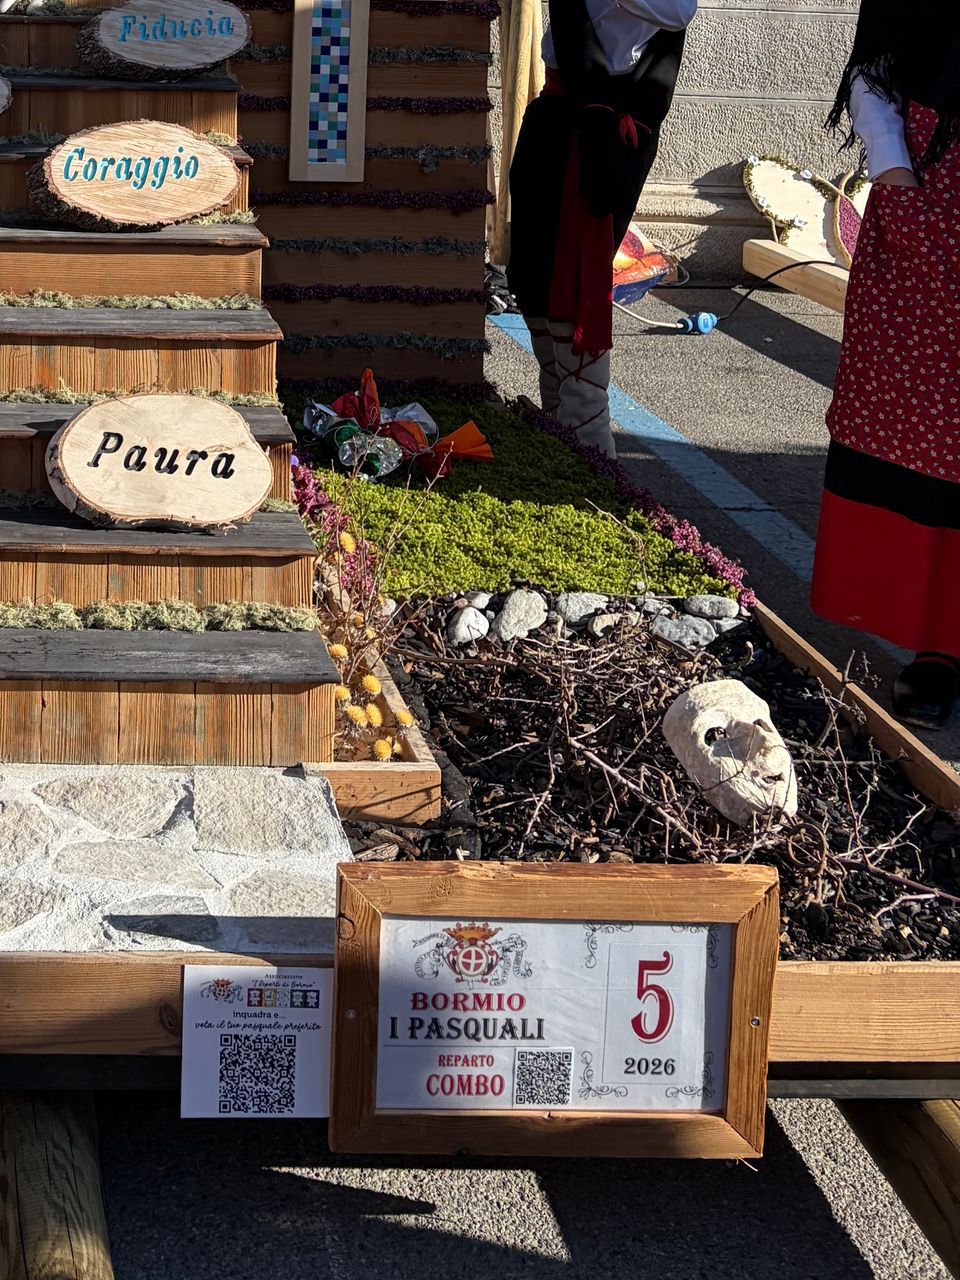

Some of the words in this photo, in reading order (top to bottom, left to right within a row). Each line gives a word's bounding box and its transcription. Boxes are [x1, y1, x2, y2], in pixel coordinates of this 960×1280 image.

[118, 10, 234, 43] Fiducia
[62, 146, 200, 190] Coraggio
[86, 431, 236, 480] Paura
[411, 992, 527, 1013] BORMIO
[631, 950, 675, 1044] 5
[195, 1020, 215, 1029] vota
[216, 1020, 225, 1029] il
[227, 1020, 241, 1029] tuo
[242, 1021, 283, 1032] pasquale
[283, 1022, 322, 1033] preferito
[233, 1011, 272, 1019] inquadra
[390, 1017, 400, 1039] I
[408, 1017, 545, 1041] PASQUALI
[438, 1054, 494, 1068] REPARTO
[623, 1057, 676, 1076] 2026
[426, 1074, 505, 1097] COMBO
